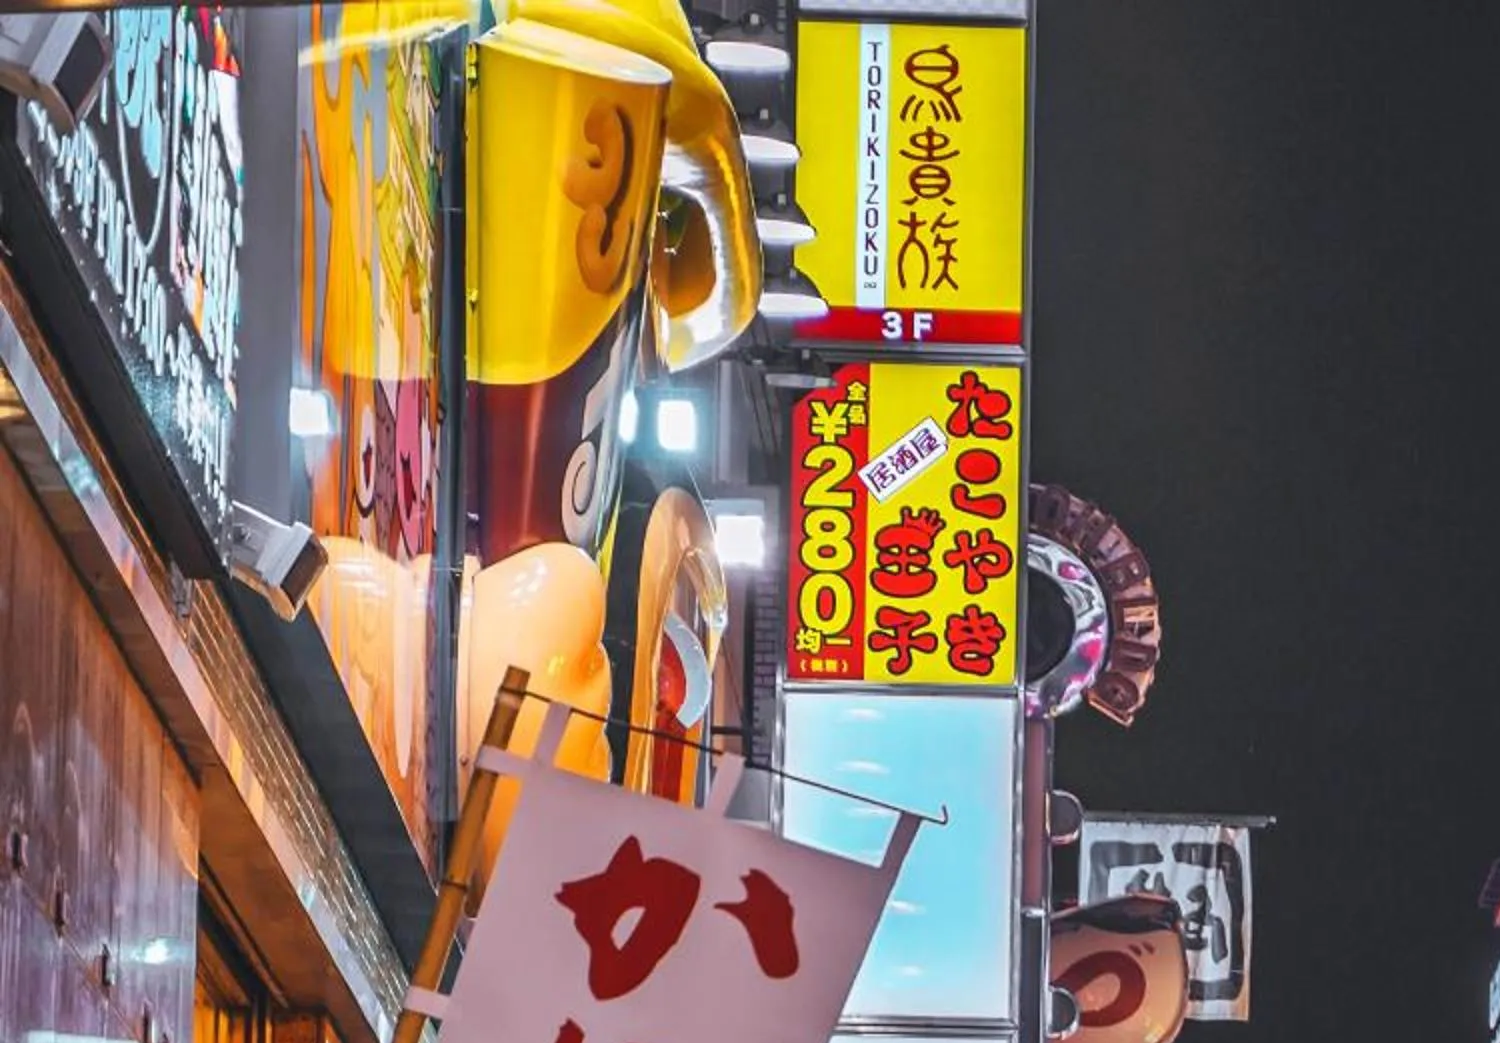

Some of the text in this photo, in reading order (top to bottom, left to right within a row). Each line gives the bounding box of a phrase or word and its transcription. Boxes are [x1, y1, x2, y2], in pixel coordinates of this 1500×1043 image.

[863, 42, 882, 276] TORIKIZOKU
[866, 426, 942, 494] 居酒屋
[943, 371, 1012, 676] たこやき
